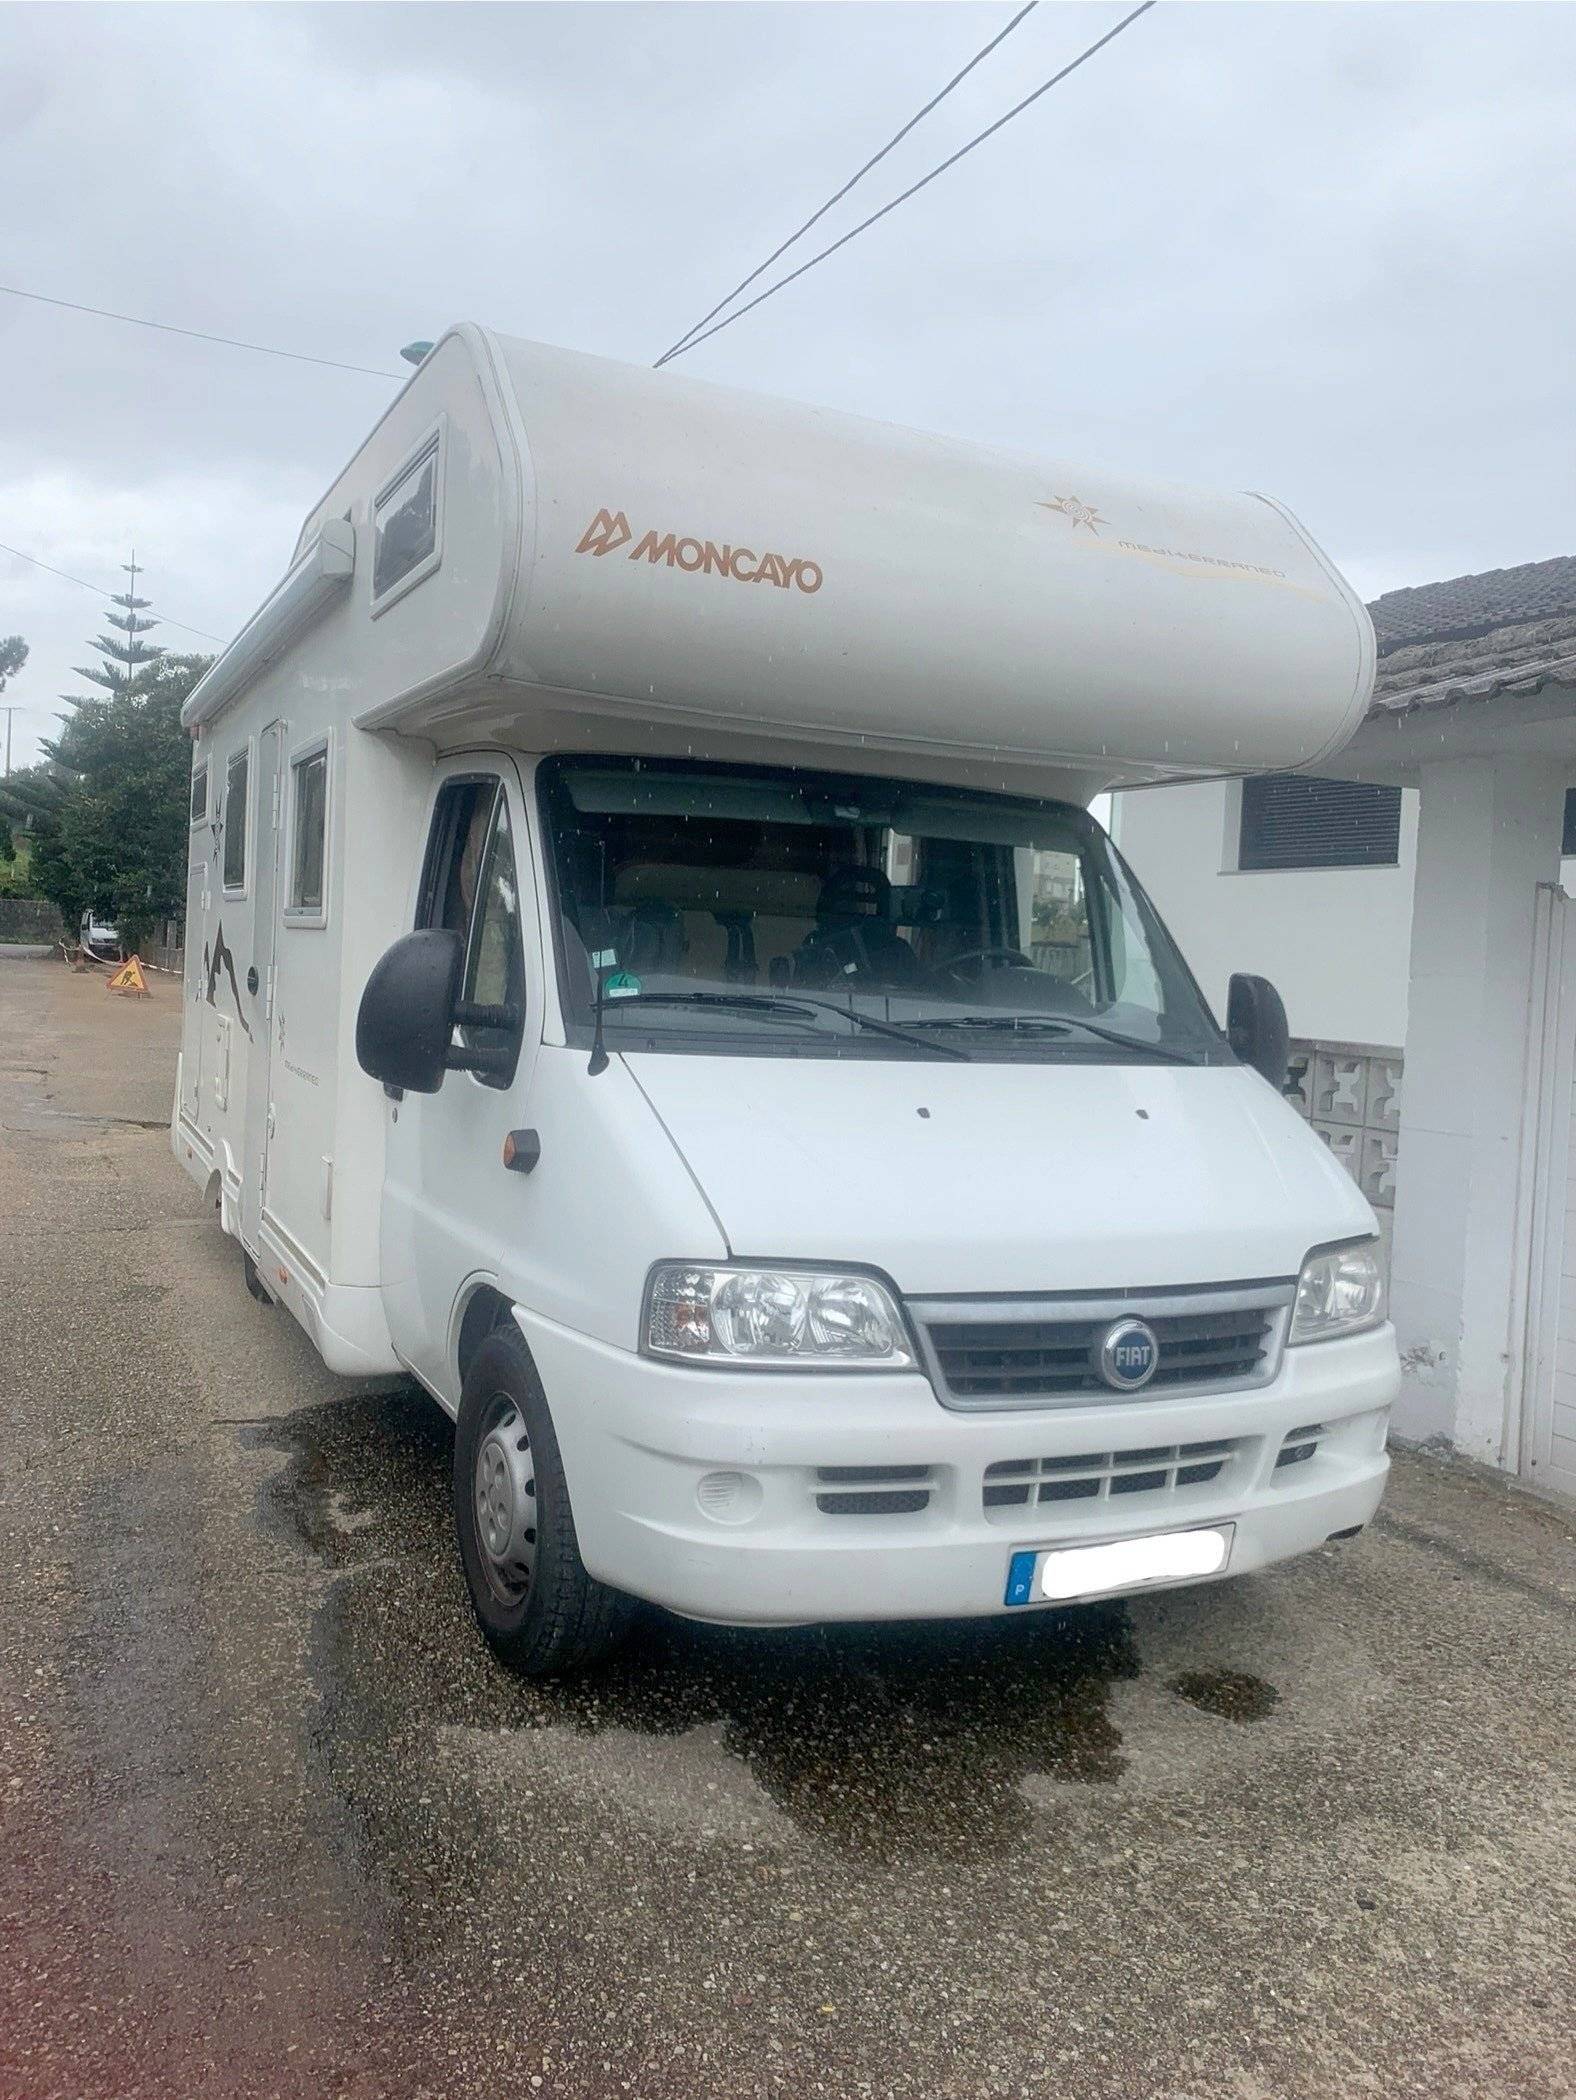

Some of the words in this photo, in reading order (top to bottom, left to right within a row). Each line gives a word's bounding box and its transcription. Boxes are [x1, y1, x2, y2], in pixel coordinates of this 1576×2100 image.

[629, 530, 823, 593] MONCAYO
[617, 972, 629, 988] 4
[1116, 1346, 1150, 1366] FIAT
[1015, 1584, 1025, 1596] P
